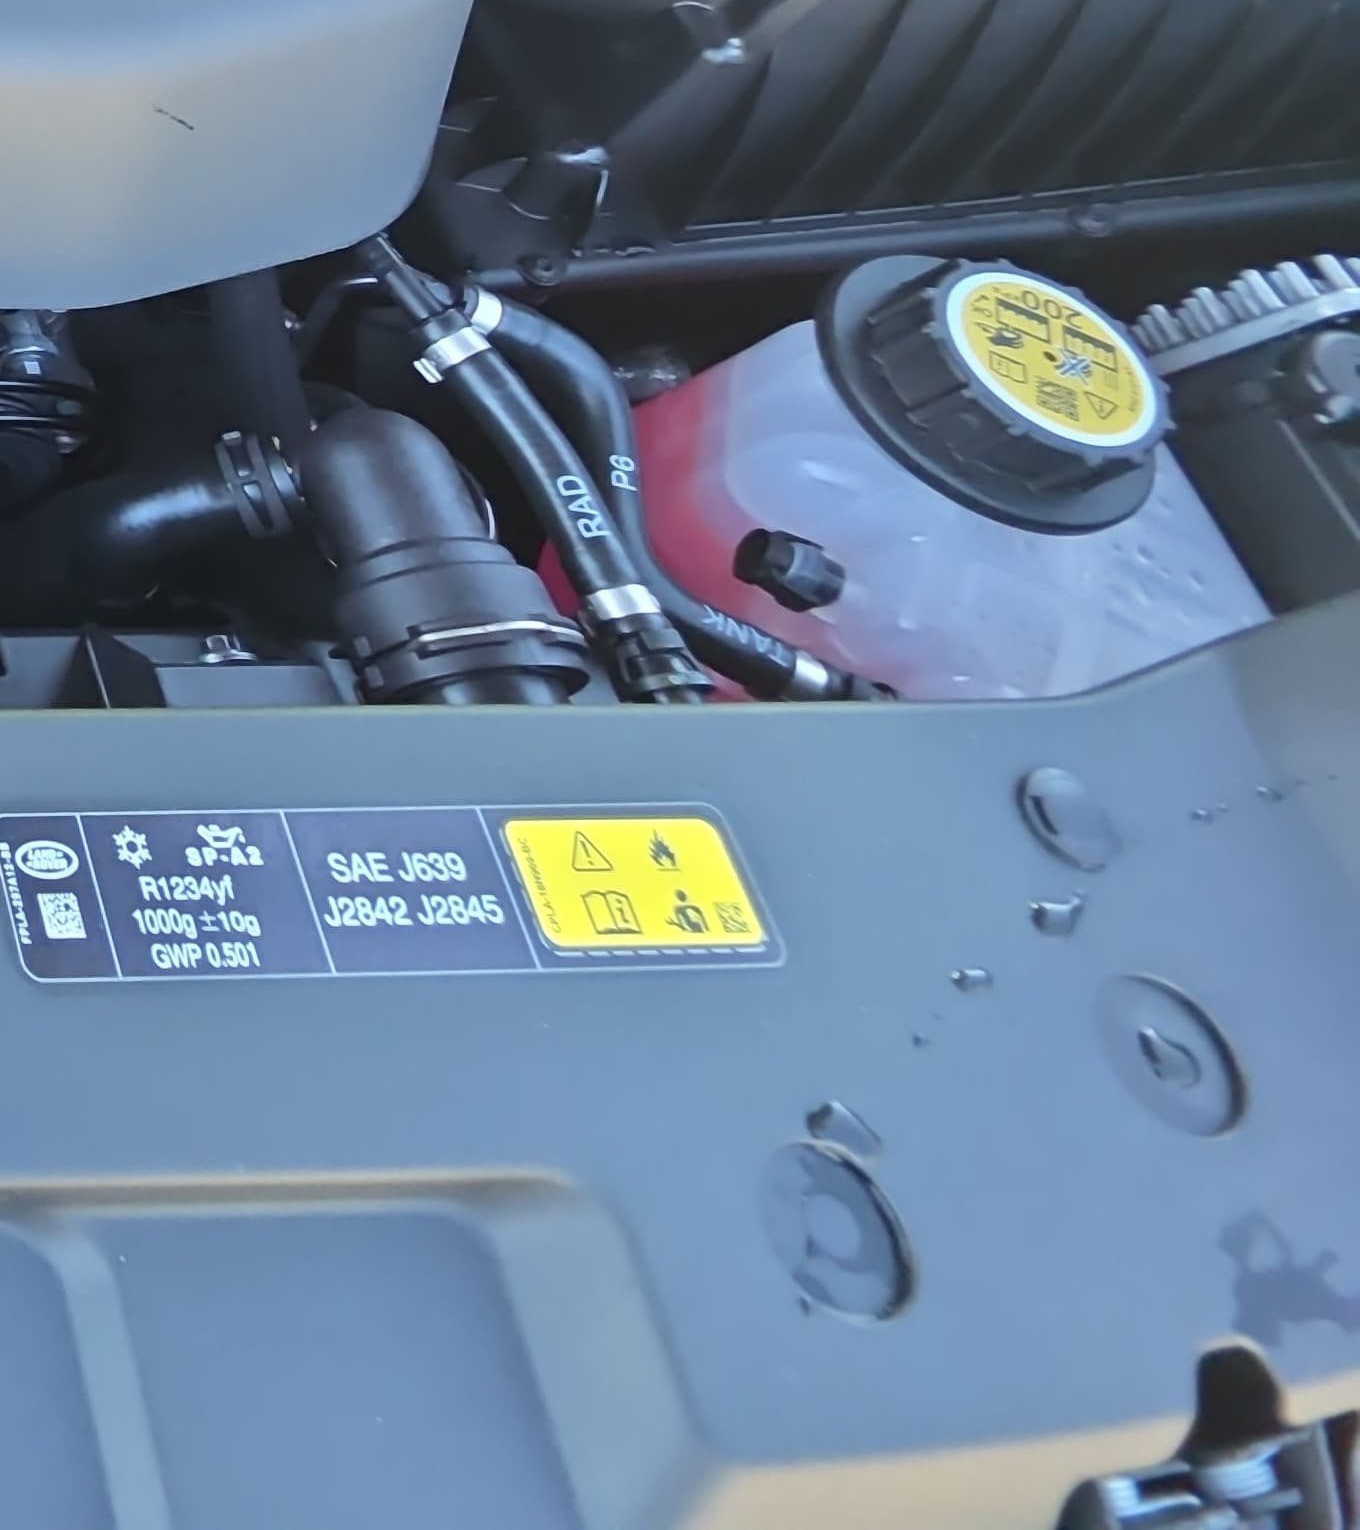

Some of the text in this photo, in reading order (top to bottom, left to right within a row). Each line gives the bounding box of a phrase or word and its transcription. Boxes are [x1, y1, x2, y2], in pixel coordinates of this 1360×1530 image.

[608, 454, 639, 492] P6
[556, 474, 611, 539] RAD
[700, 603, 795, 668] TANK
[184, 846, 265, 868] SP-A2
[326, 851, 468, 883] SAE J639
[138, 874, 236, 906] R1234yf
[131, 909, 200, 940] 1000g
[323, 893, 506, 928] J2842 J2845
[151, 941, 261, 970] GWP 0.501
